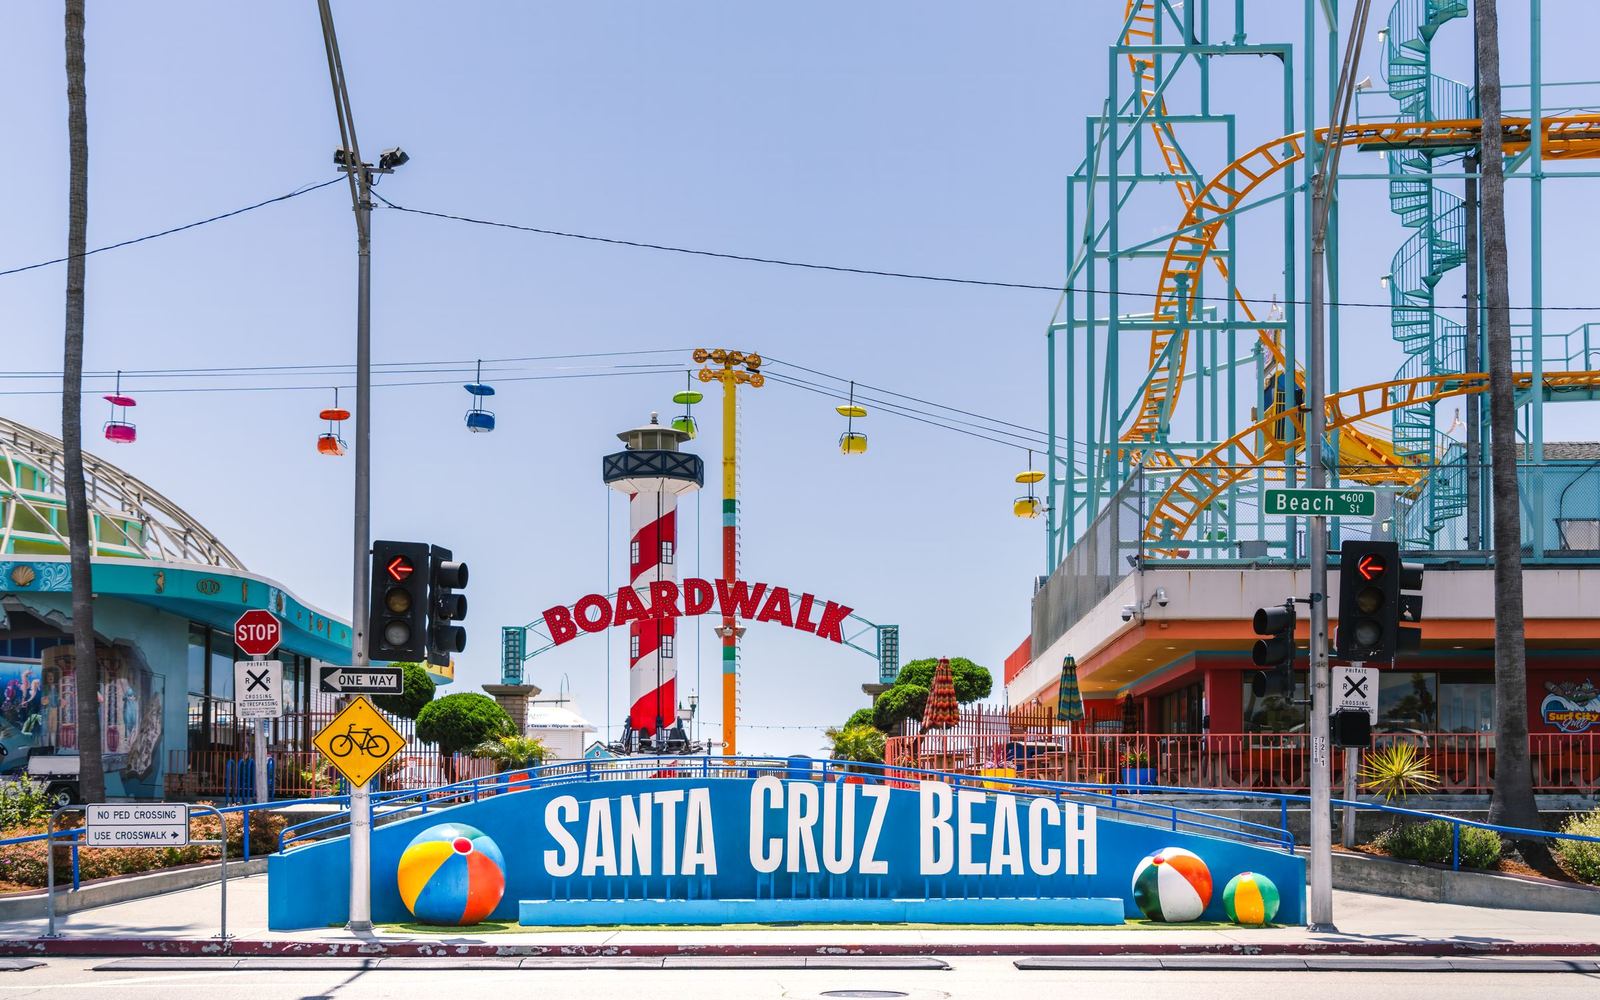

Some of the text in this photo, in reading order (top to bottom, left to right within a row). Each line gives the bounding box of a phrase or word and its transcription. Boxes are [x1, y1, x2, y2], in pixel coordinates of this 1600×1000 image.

[1277, 494, 1334, 511] Beach
[1346, 493, 1364, 503] 600
[1349, 504, 1360, 513] St
[542, 578, 854, 646] BOARDWALK
[238, 624, 277, 641] STOP
[338, 675, 394, 686] ONE WAY
[1548, 712, 1599, 722] Surf City
[97, 810, 177, 820] NO PED CROSSING
[543, 776, 1098, 877] SANTA CRUZ BEACH
[94, 831, 167, 840] USE CROSSWALK
